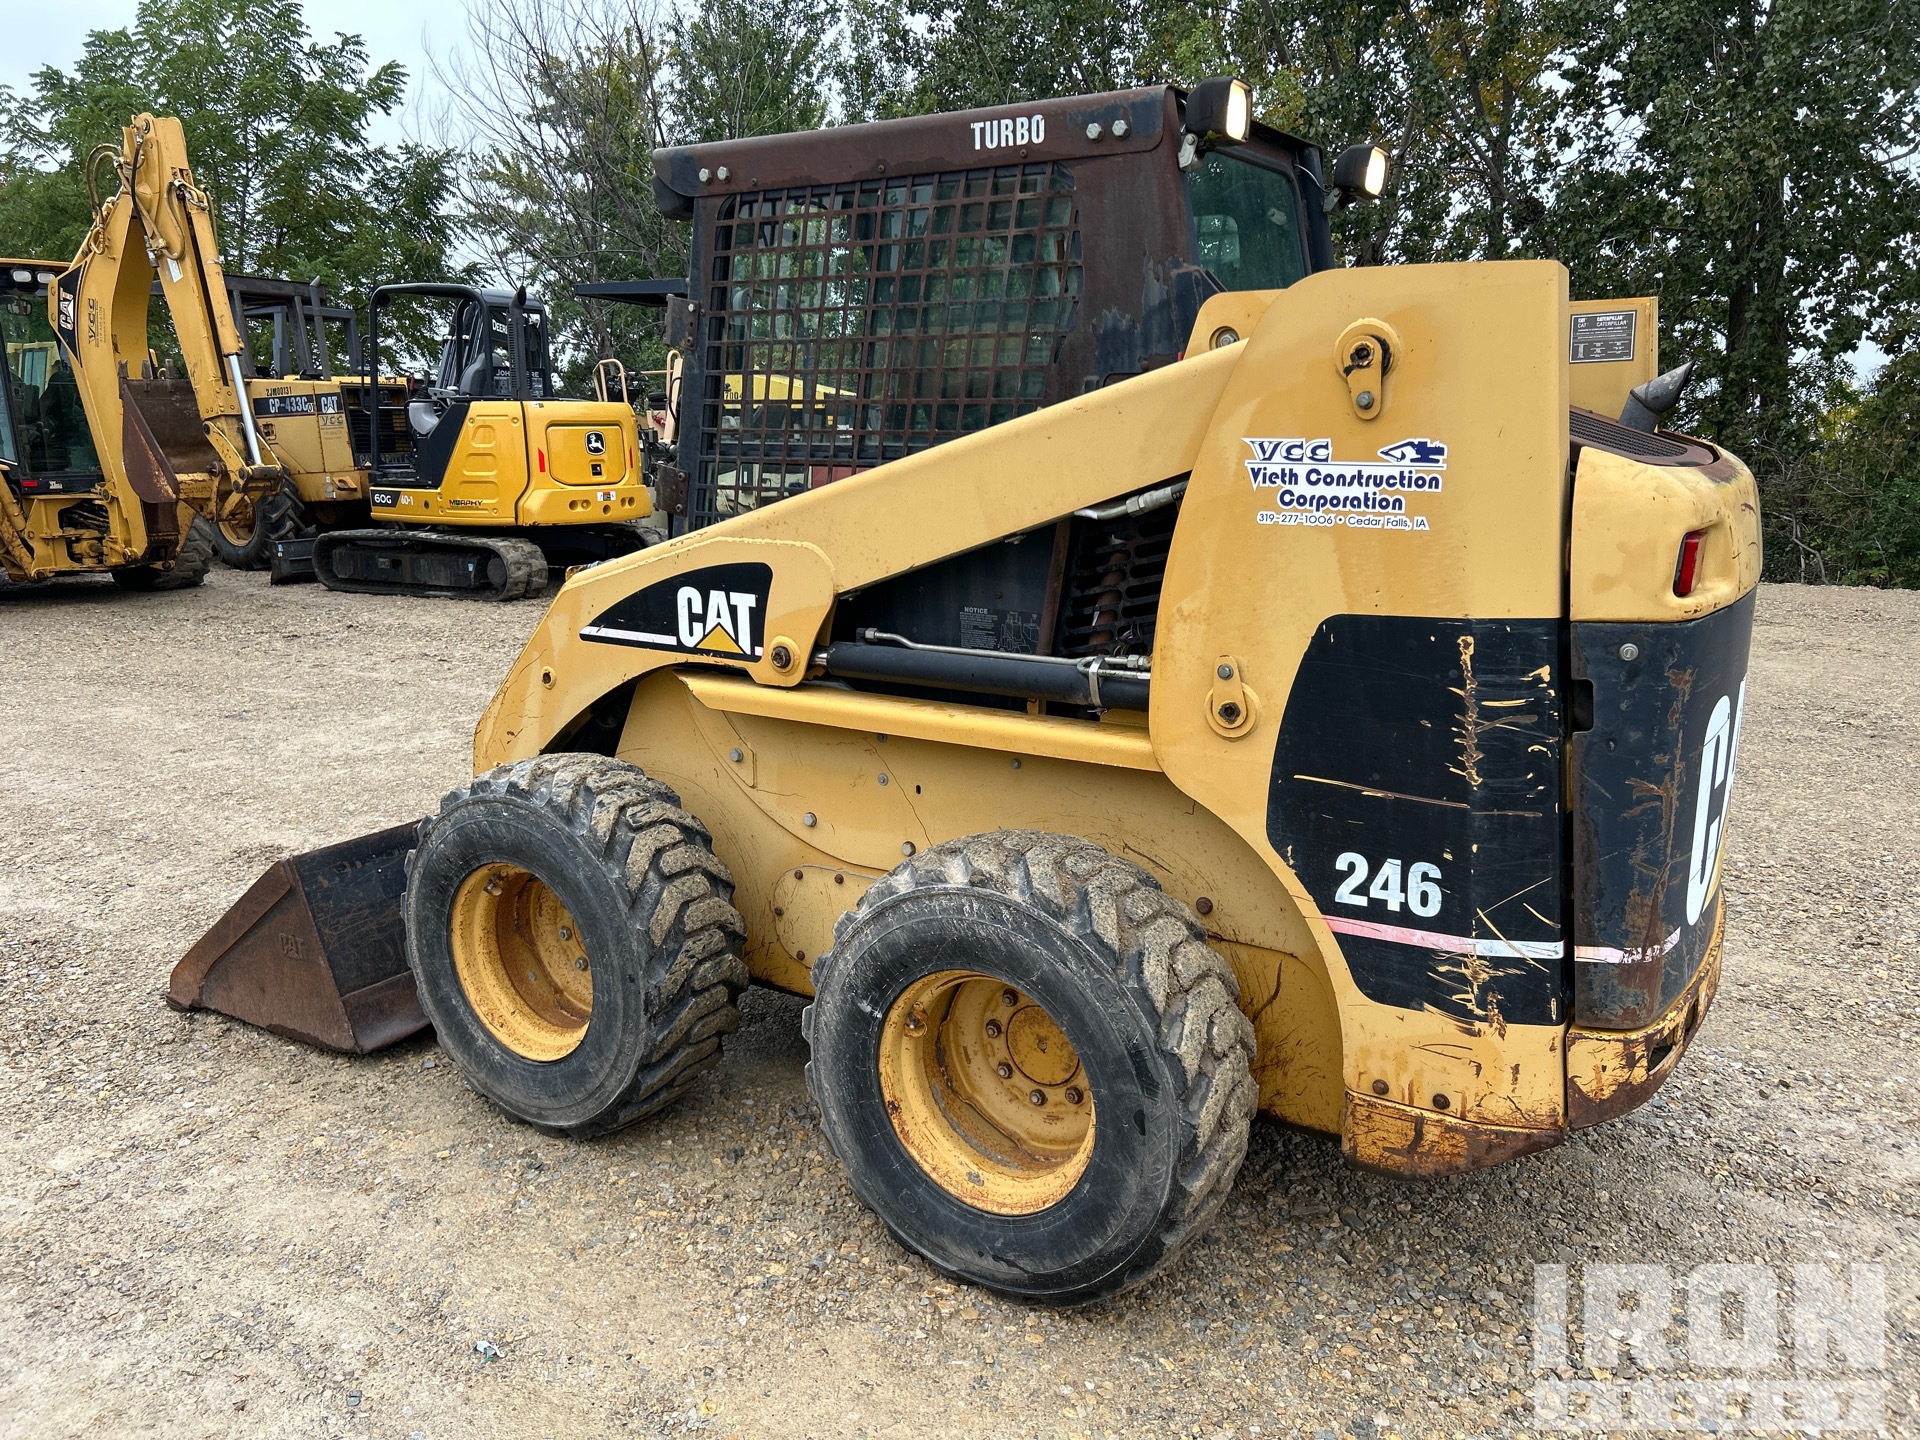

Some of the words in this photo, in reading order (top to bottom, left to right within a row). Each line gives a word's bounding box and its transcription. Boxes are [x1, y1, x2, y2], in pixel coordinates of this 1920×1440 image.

[970, 114, 1045, 150] TURBO
[60, 286, 74, 331] CAT
[269, 396, 308, 414] CP-433C
[320, 395, 339, 414] CAT
[1249, 440, 1330, 463] VCC
[1250, 466, 1299, 486] Vieth
[1305, 468, 1440, 490] Construction
[374, 493, 392, 504] 60G
[1279, 489, 1403, 512] Corporation
[1258, 513, 1333, 525] 319-277-1006
[1348, 516, 1382, 527] Cedar
[1386, 517, 1411, 528] Falls,
[1415, 518, 1427, 528] IA
[677, 586, 757, 656] CAT
[964, 606, 988, 615] NOTICE
[1334, 852, 1443, 918] 246
